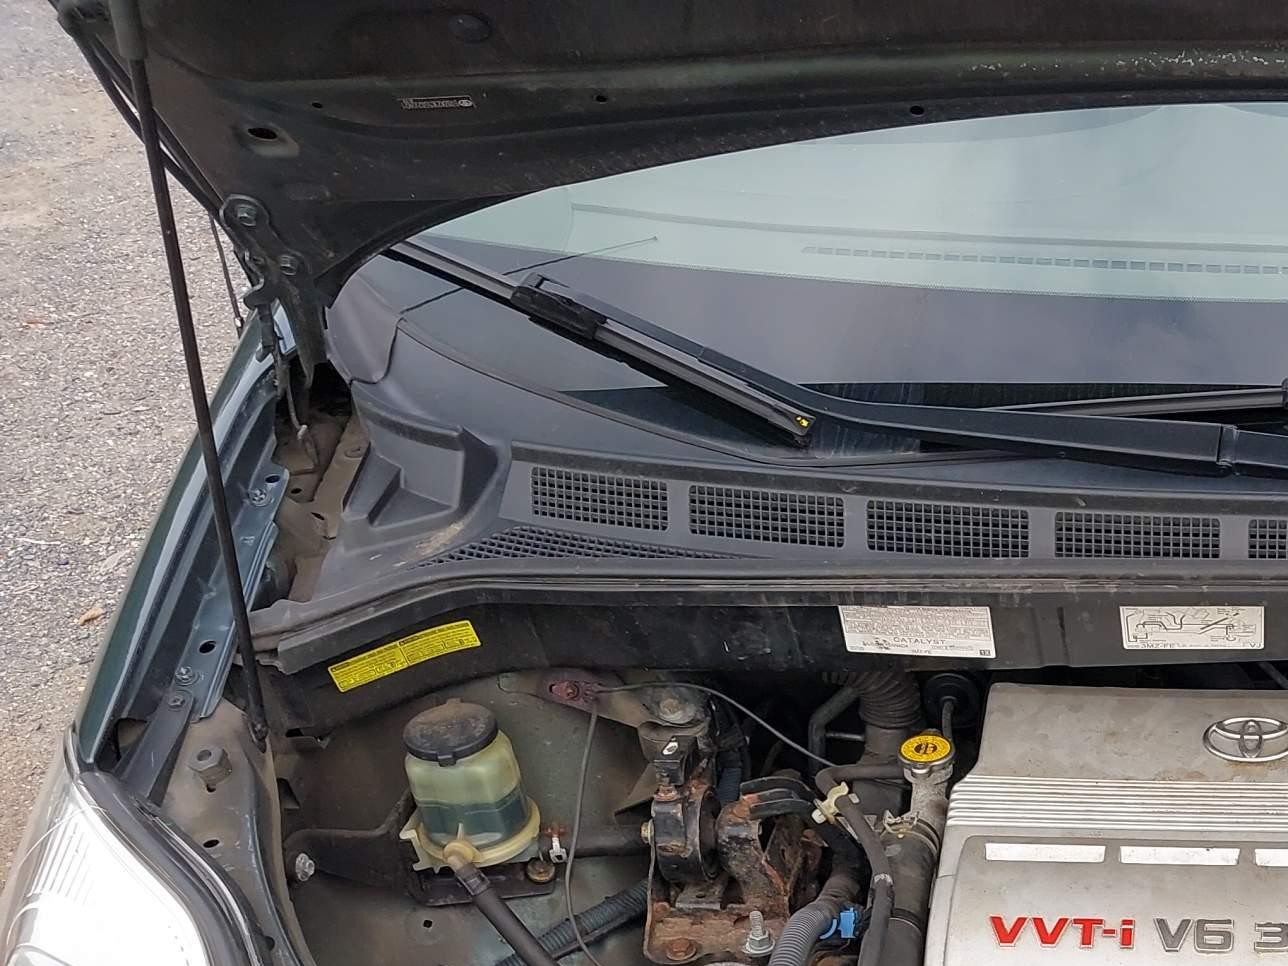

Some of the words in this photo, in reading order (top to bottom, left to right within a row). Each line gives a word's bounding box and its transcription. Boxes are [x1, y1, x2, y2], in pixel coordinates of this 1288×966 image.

[893, 636, 946, 645] CATALYST
[989, 915, 1136, 950] VVT-i
[1152, 917, 1236, 954] V6
